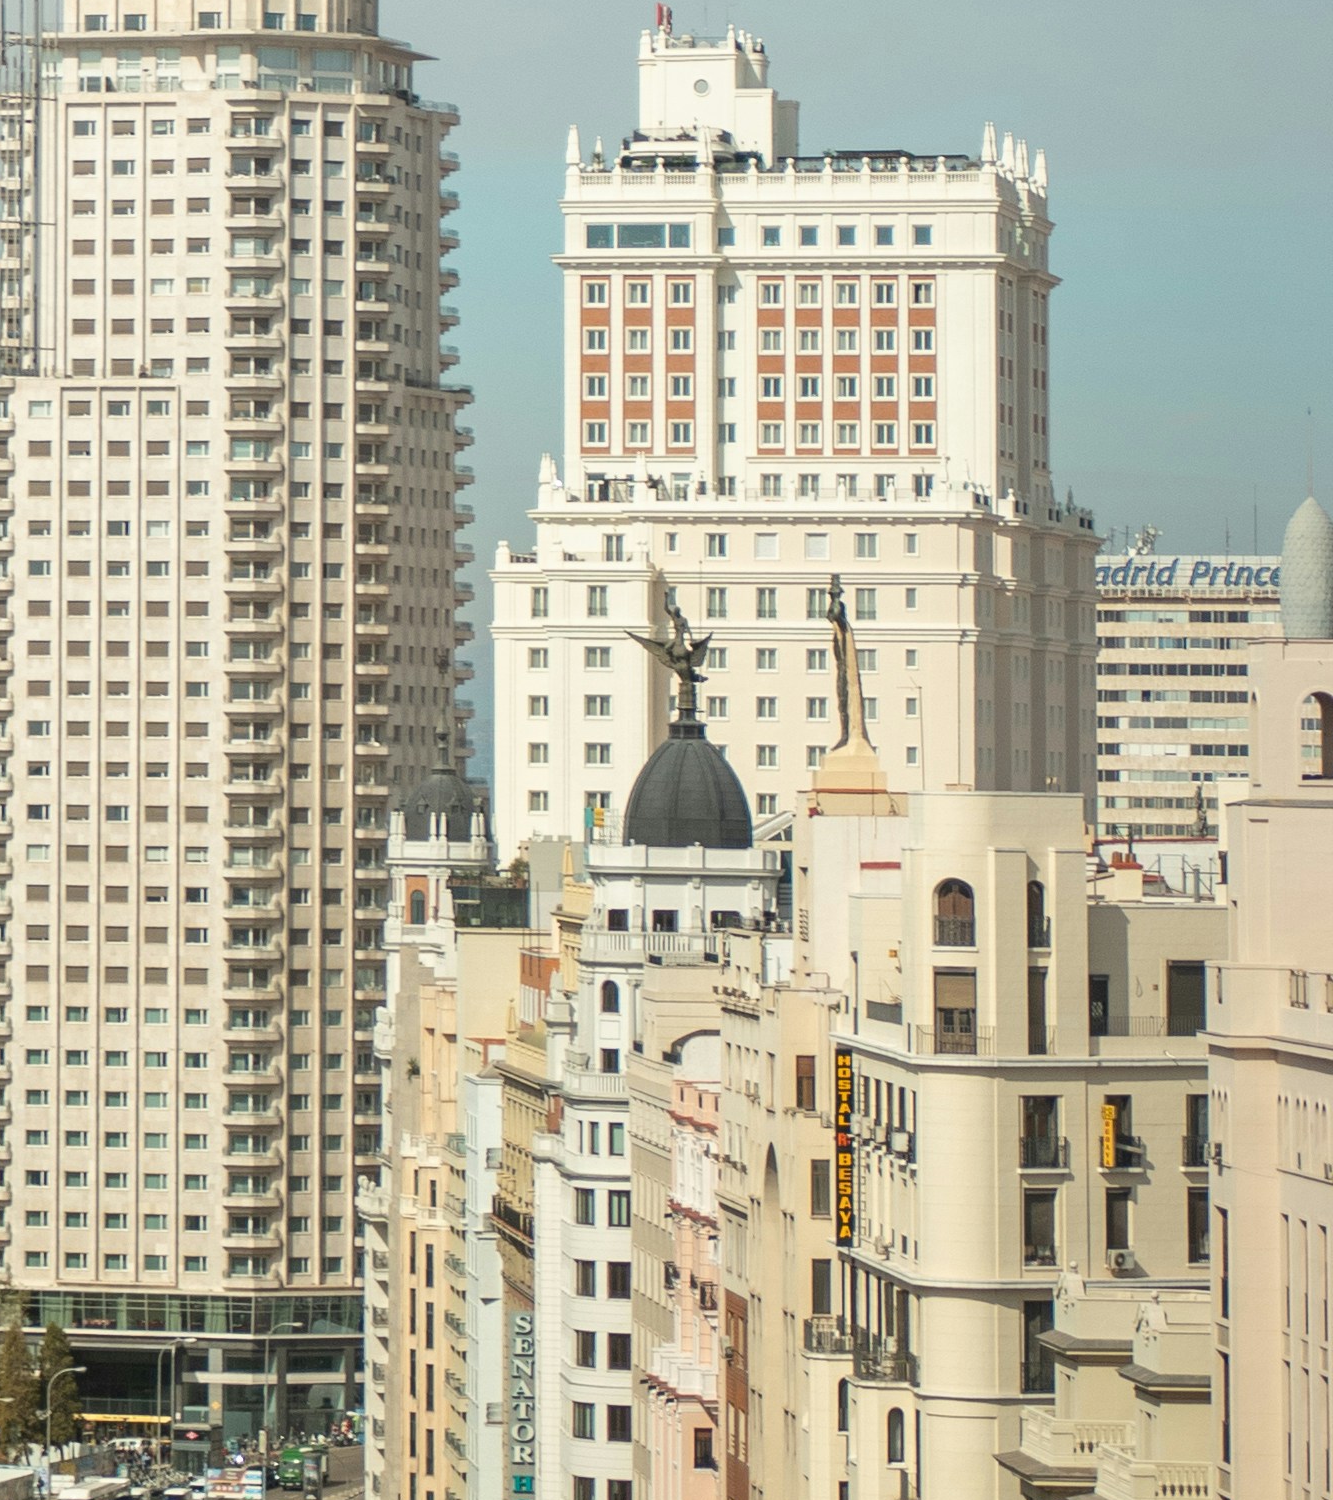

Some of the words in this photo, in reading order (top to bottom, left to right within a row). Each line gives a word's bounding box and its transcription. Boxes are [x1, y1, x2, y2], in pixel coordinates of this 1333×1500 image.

[837, 1055, 851, 1126] HOSTAL
[838, 1153, 852, 1239] BESAYA
[511, 1313, 535, 1466] SENATOR
